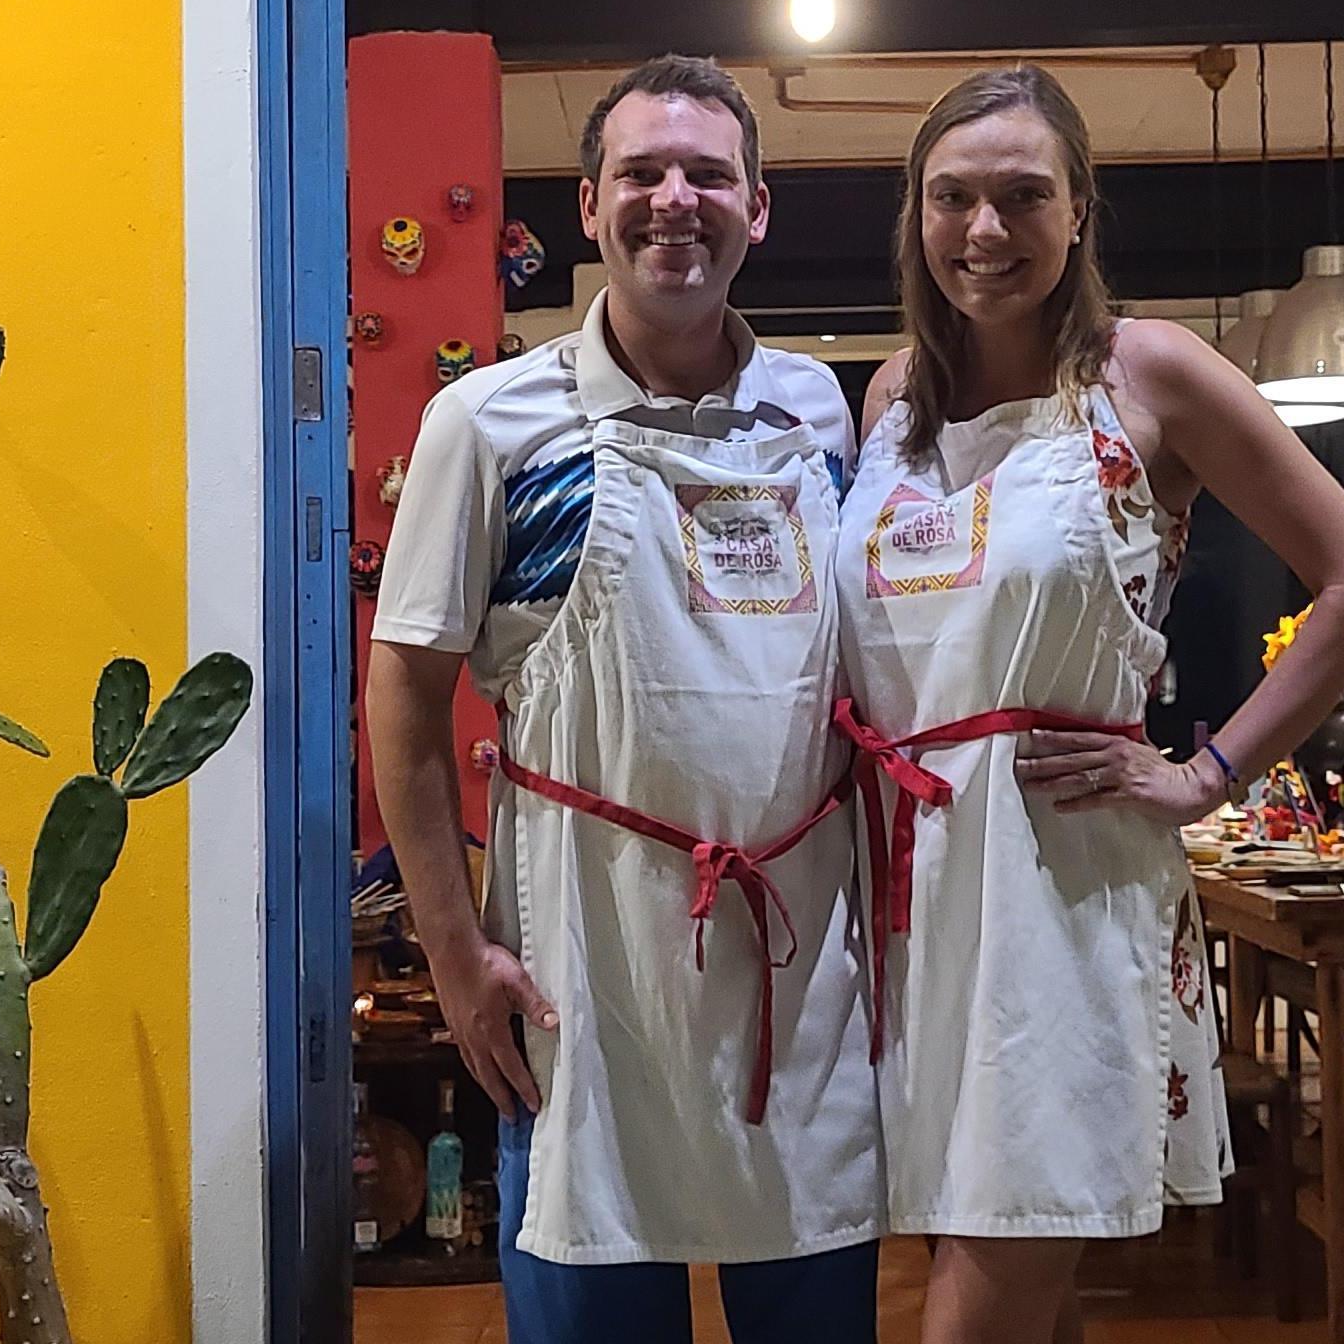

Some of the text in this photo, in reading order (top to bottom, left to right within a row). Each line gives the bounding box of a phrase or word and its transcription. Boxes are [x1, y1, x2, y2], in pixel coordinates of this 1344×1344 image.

[726, 538, 773, 552] CASA
[892, 527, 956, 547] DE ROSA
[714, 553, 783, 569] DE ROSA
